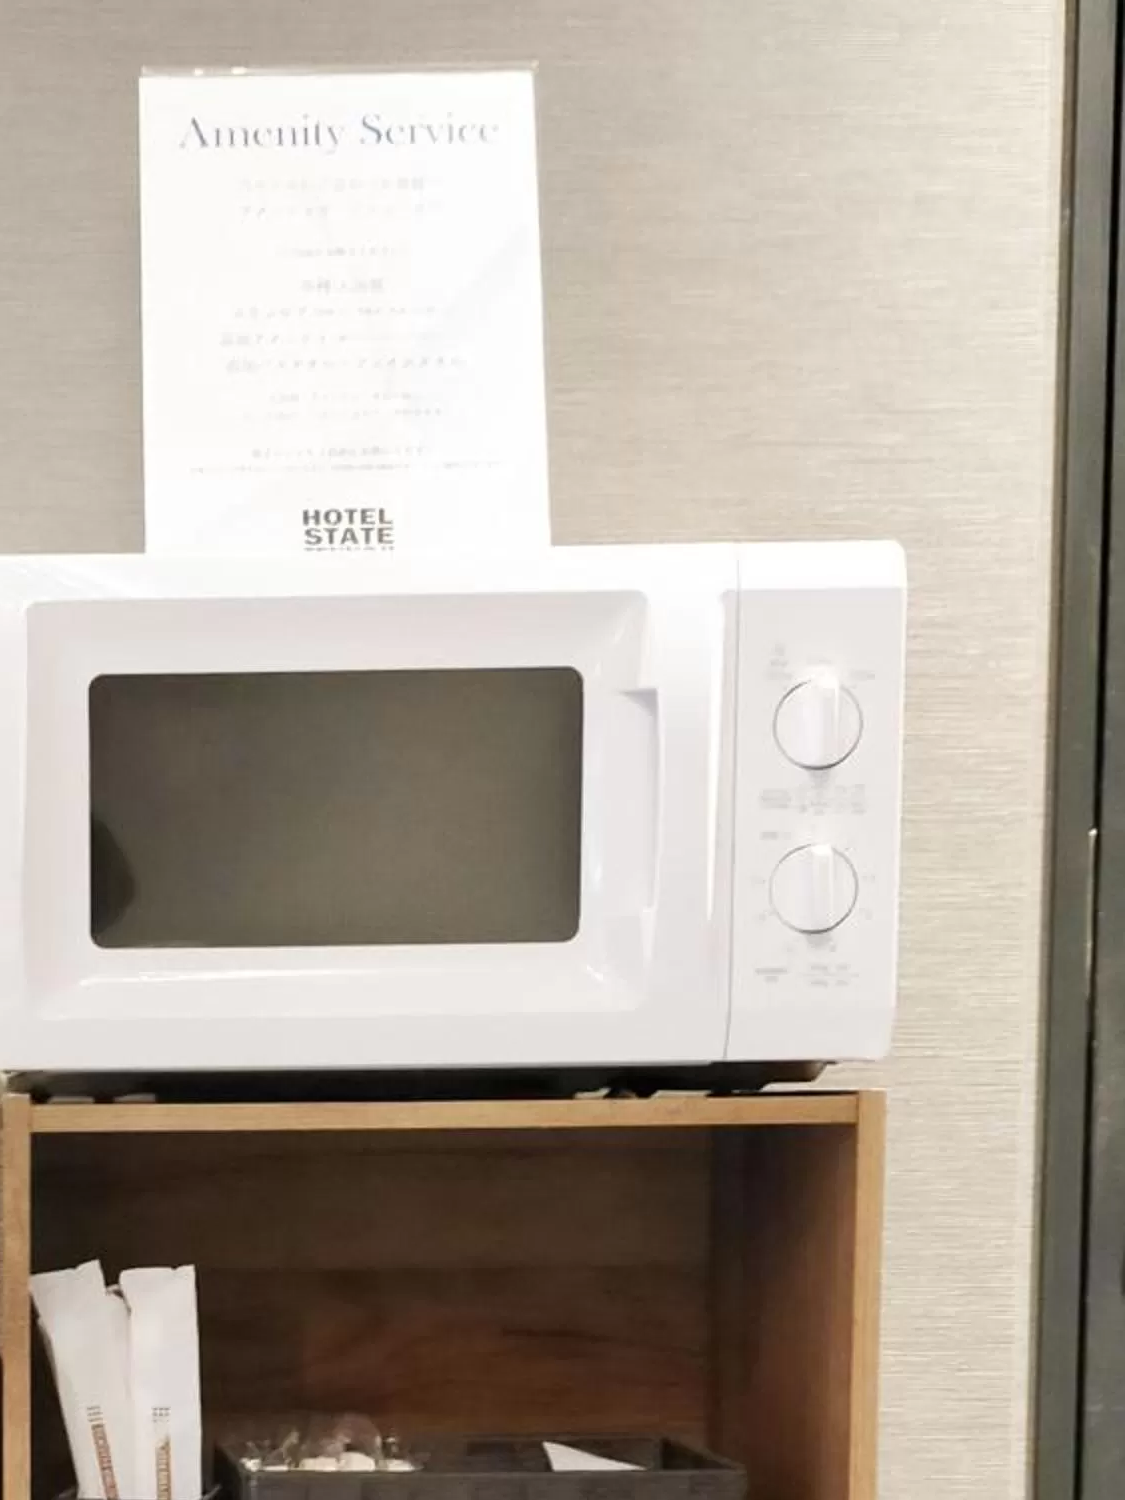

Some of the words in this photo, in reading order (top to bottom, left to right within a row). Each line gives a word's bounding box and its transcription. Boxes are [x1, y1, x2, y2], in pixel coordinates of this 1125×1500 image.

[179, 113, 345, 155] Amenity
[359, 111, 500, 147] Service
[302, 507, 394, 526] HOTEL
[303, 527, 395, 545] STATE
